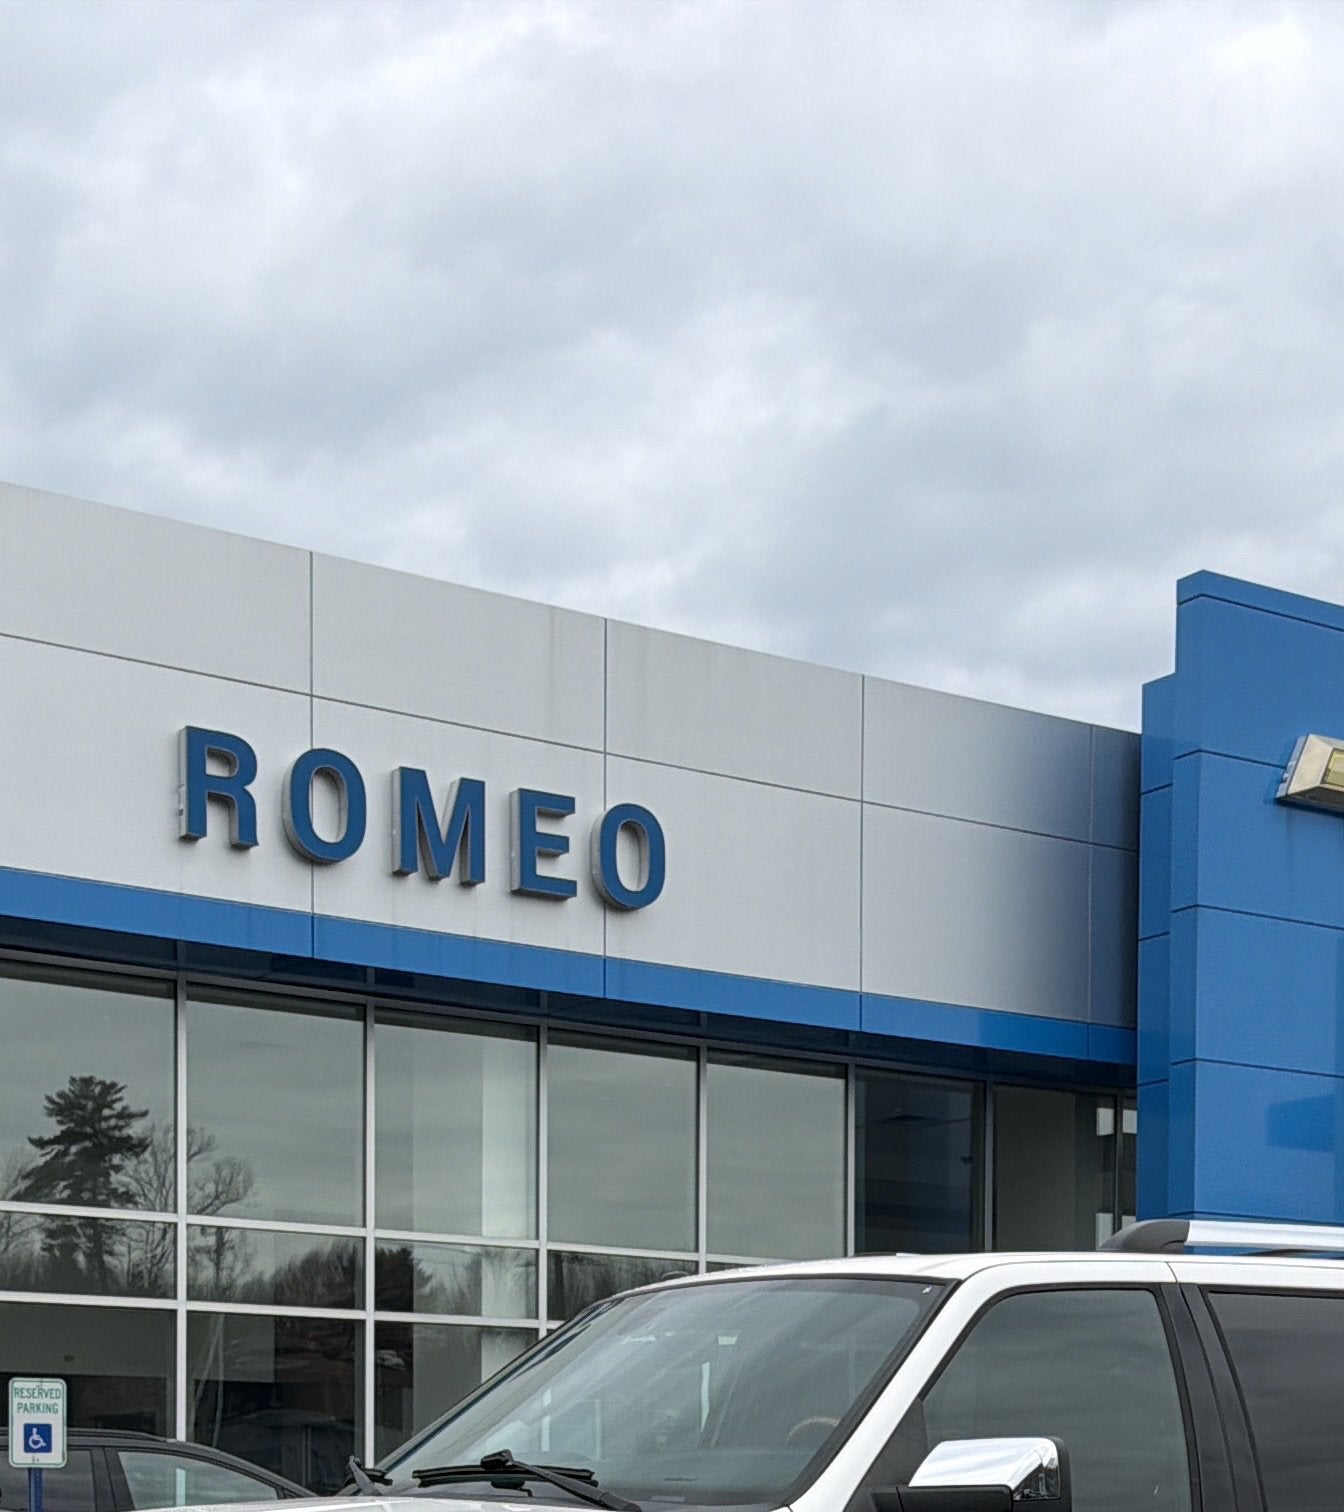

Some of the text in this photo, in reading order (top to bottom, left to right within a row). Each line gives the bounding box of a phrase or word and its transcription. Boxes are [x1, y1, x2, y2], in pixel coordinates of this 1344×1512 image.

[179, 726, 666, 910] ROMEO
[14, 1387, 61, 1399] RESERVED
[17, 1402, 59, 1414] PARKING
